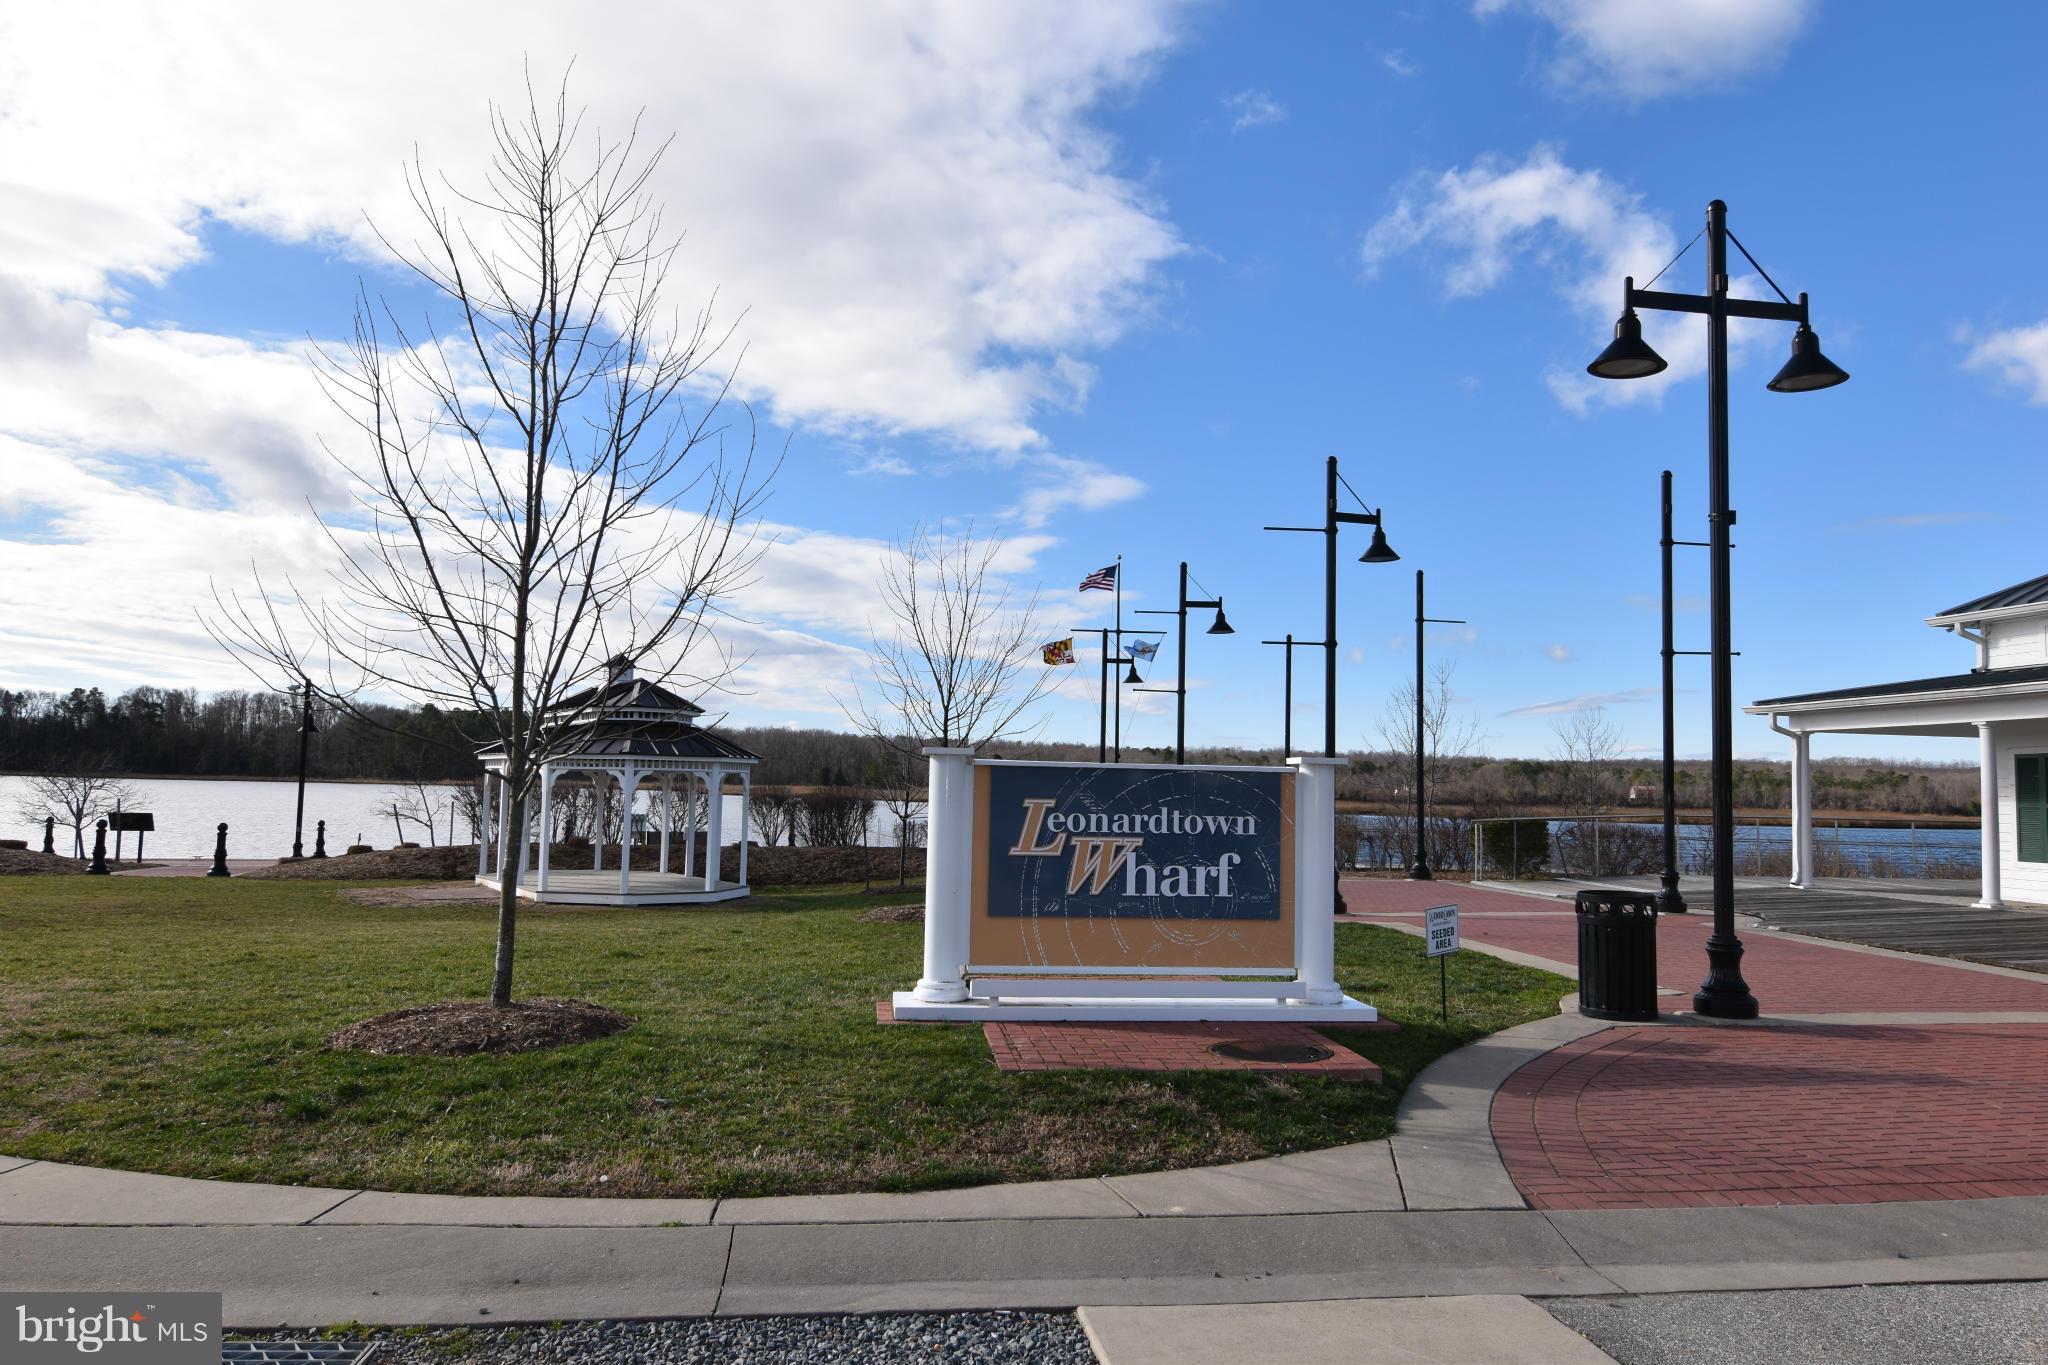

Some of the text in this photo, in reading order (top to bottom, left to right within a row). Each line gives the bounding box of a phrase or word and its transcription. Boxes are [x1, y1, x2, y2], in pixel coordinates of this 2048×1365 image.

[1008, 798, 1258, 857] Leonardtown
[1066, 836, 1242, 896] Wharf
[1431, 926, 1454, 940] SEEDED
[1435, 938, 1452, 950] AREA
